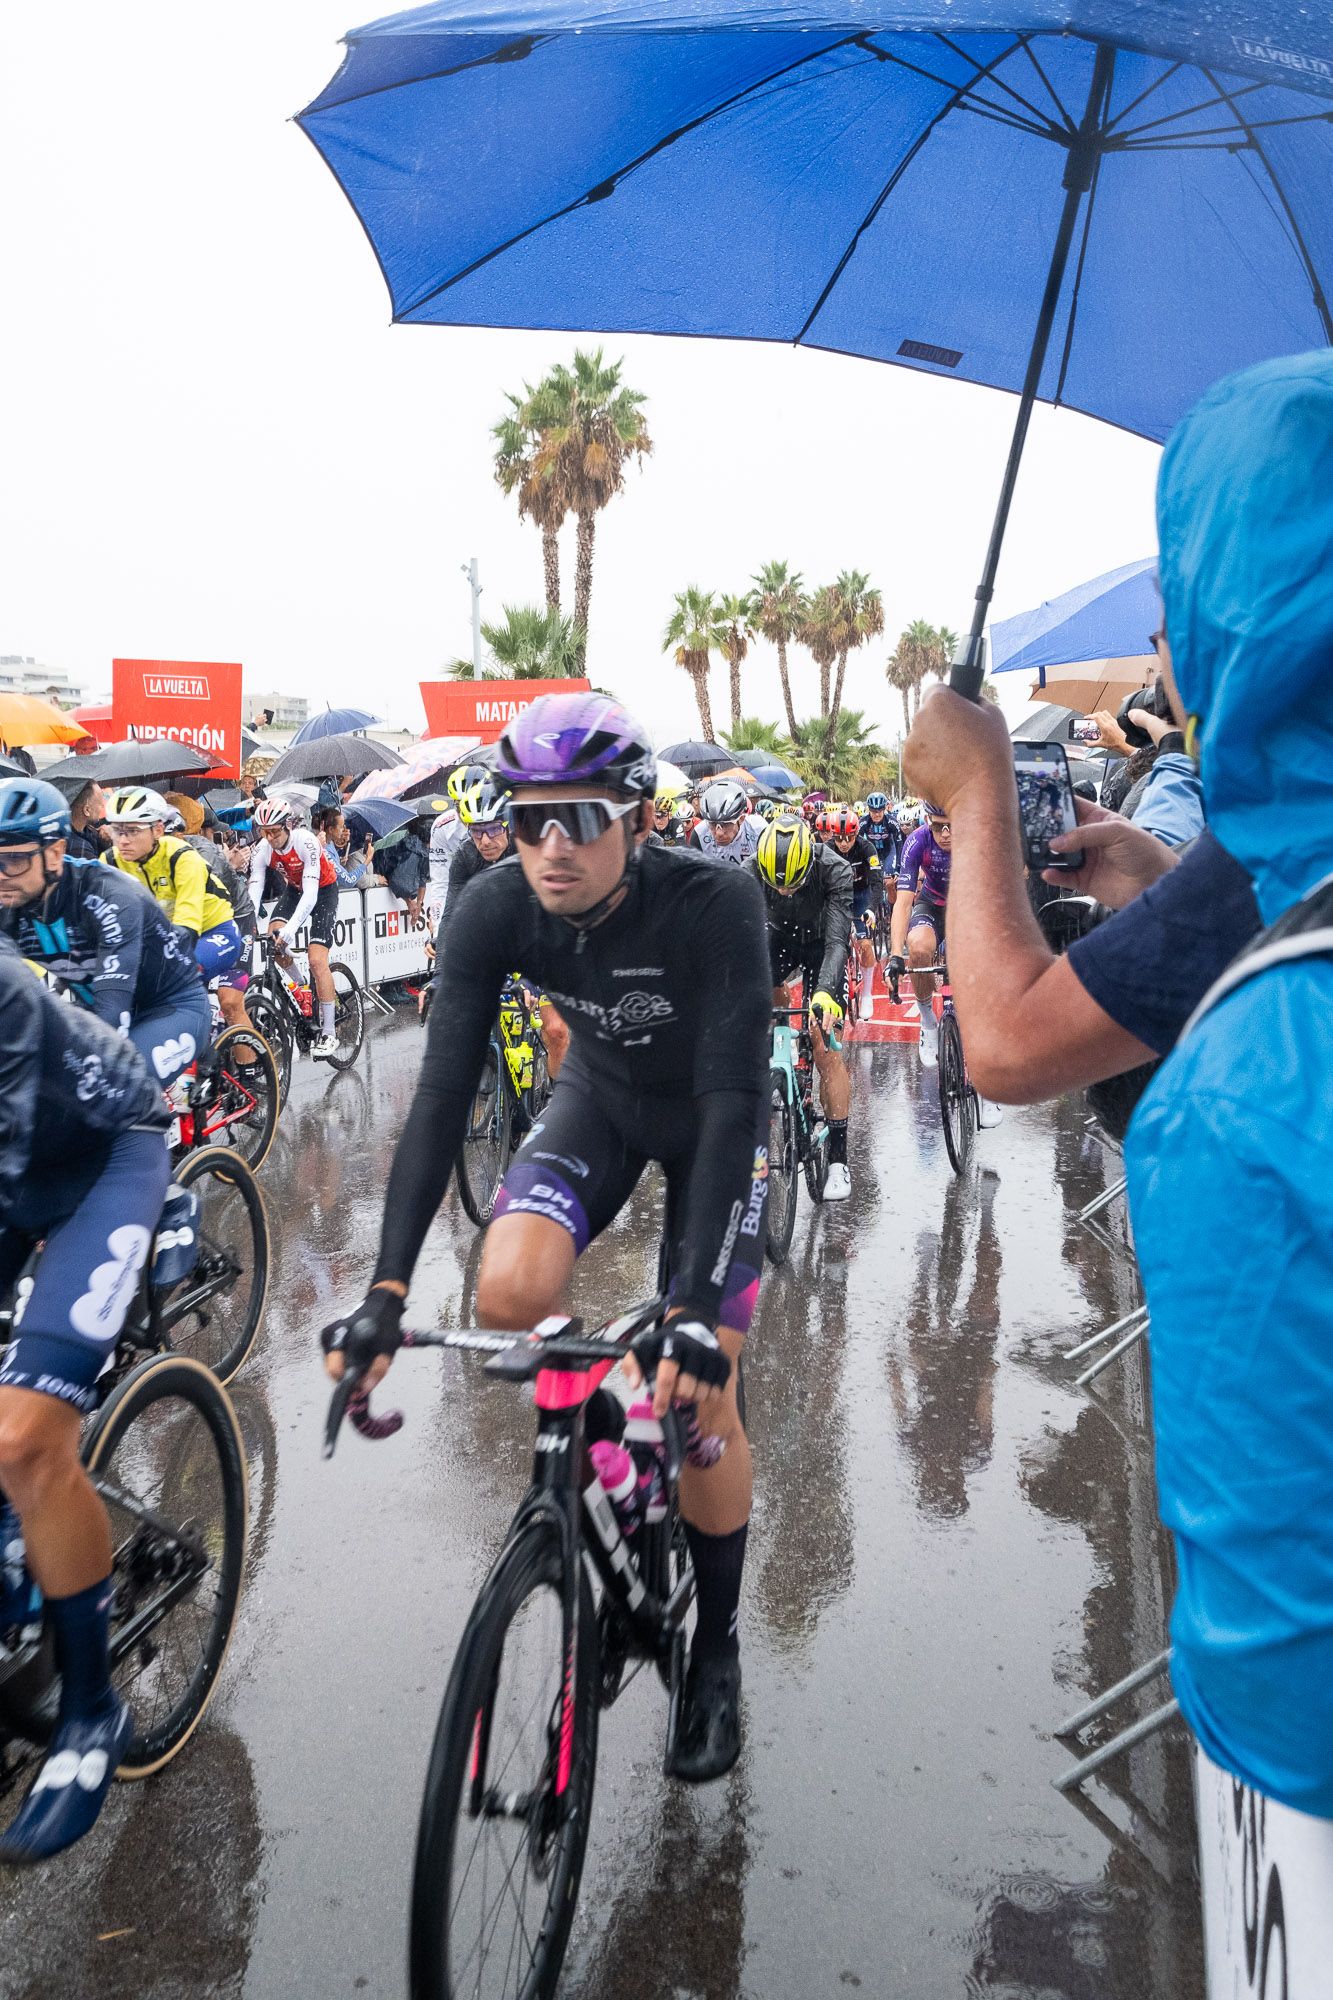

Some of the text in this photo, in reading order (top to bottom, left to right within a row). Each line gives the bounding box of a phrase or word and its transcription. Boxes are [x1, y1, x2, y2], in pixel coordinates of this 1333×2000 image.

[150, 679, 204, 695] LA VUELTA
[528, 1183, 574, 1210] BH
